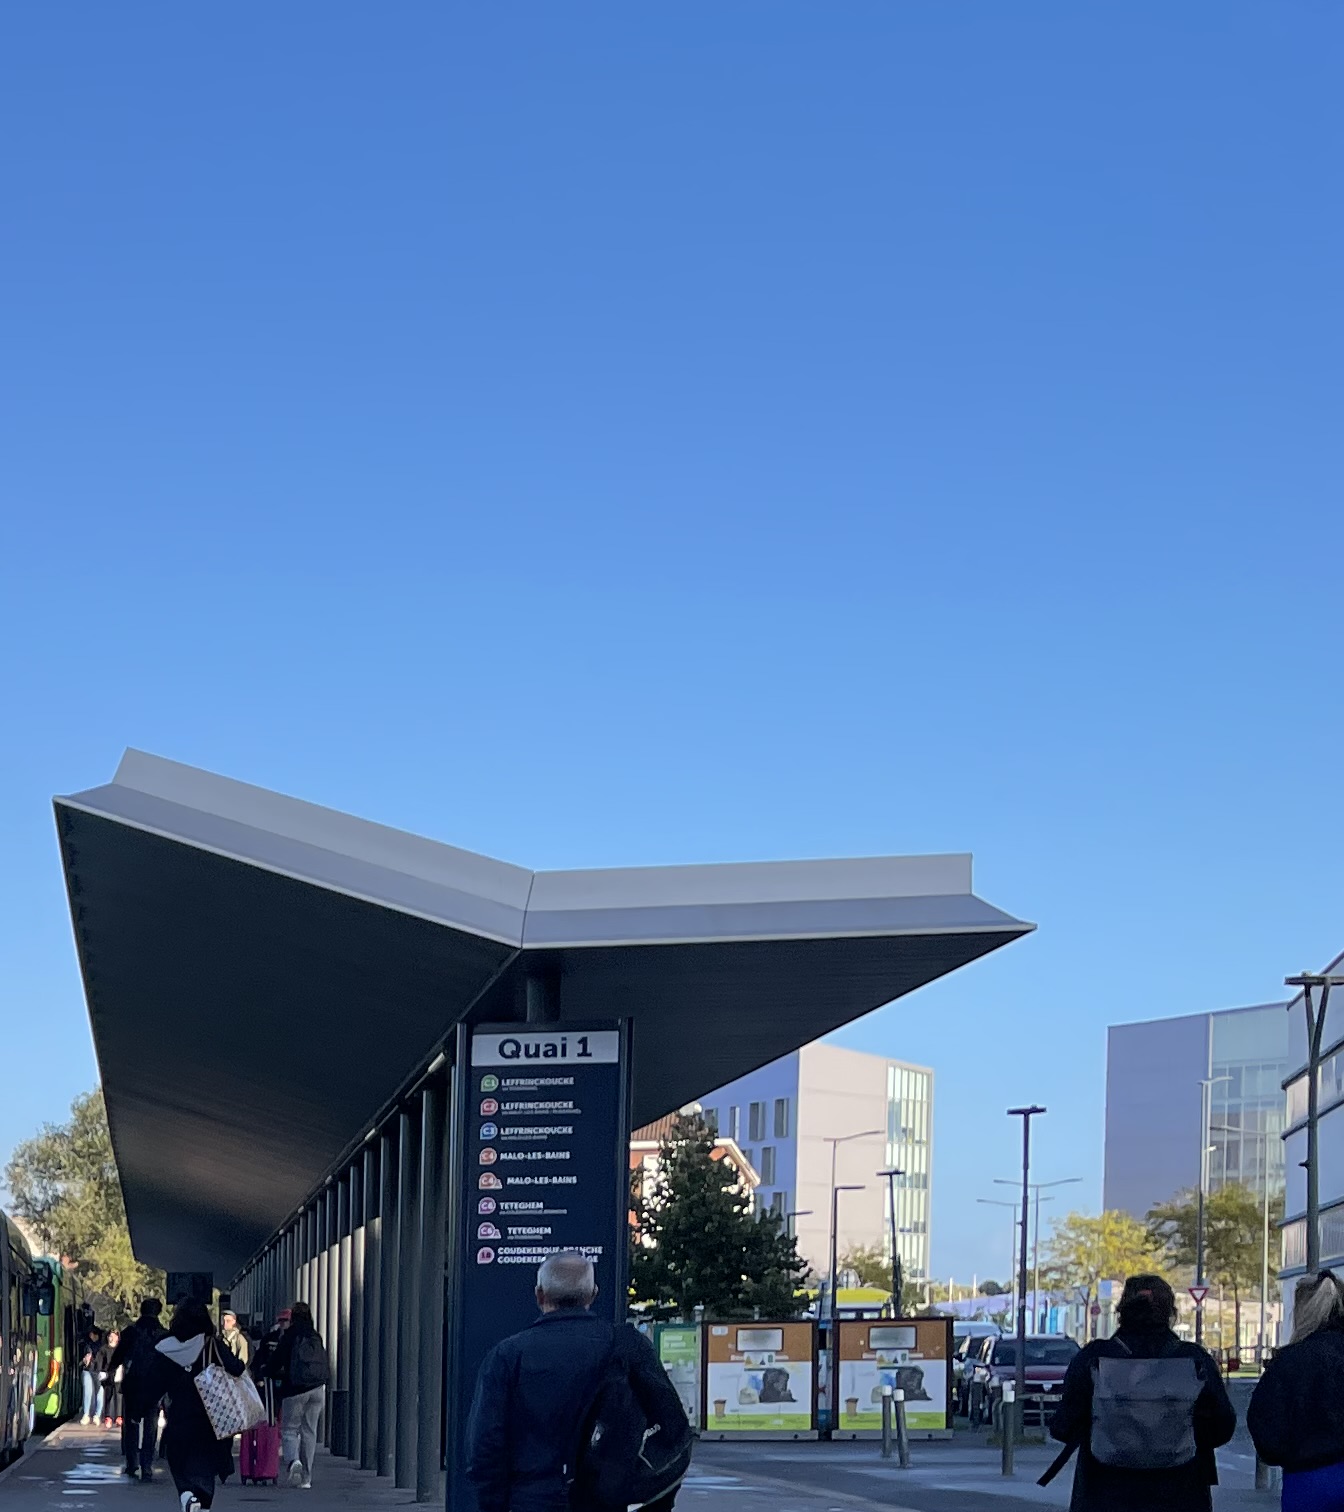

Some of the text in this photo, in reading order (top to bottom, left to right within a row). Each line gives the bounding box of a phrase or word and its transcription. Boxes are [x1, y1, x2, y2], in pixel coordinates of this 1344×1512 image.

[498, 1036, 593, 1060] Quai 1
[500, 1151, 571, 1160] MALO-LES-BAINS
[507, 1175, 578, 1185] MALO-LES-BAINS
[499, 1201, 544, 1210] TETEGHEM
[507, 1226, 552, 1235] TETEGHEM
